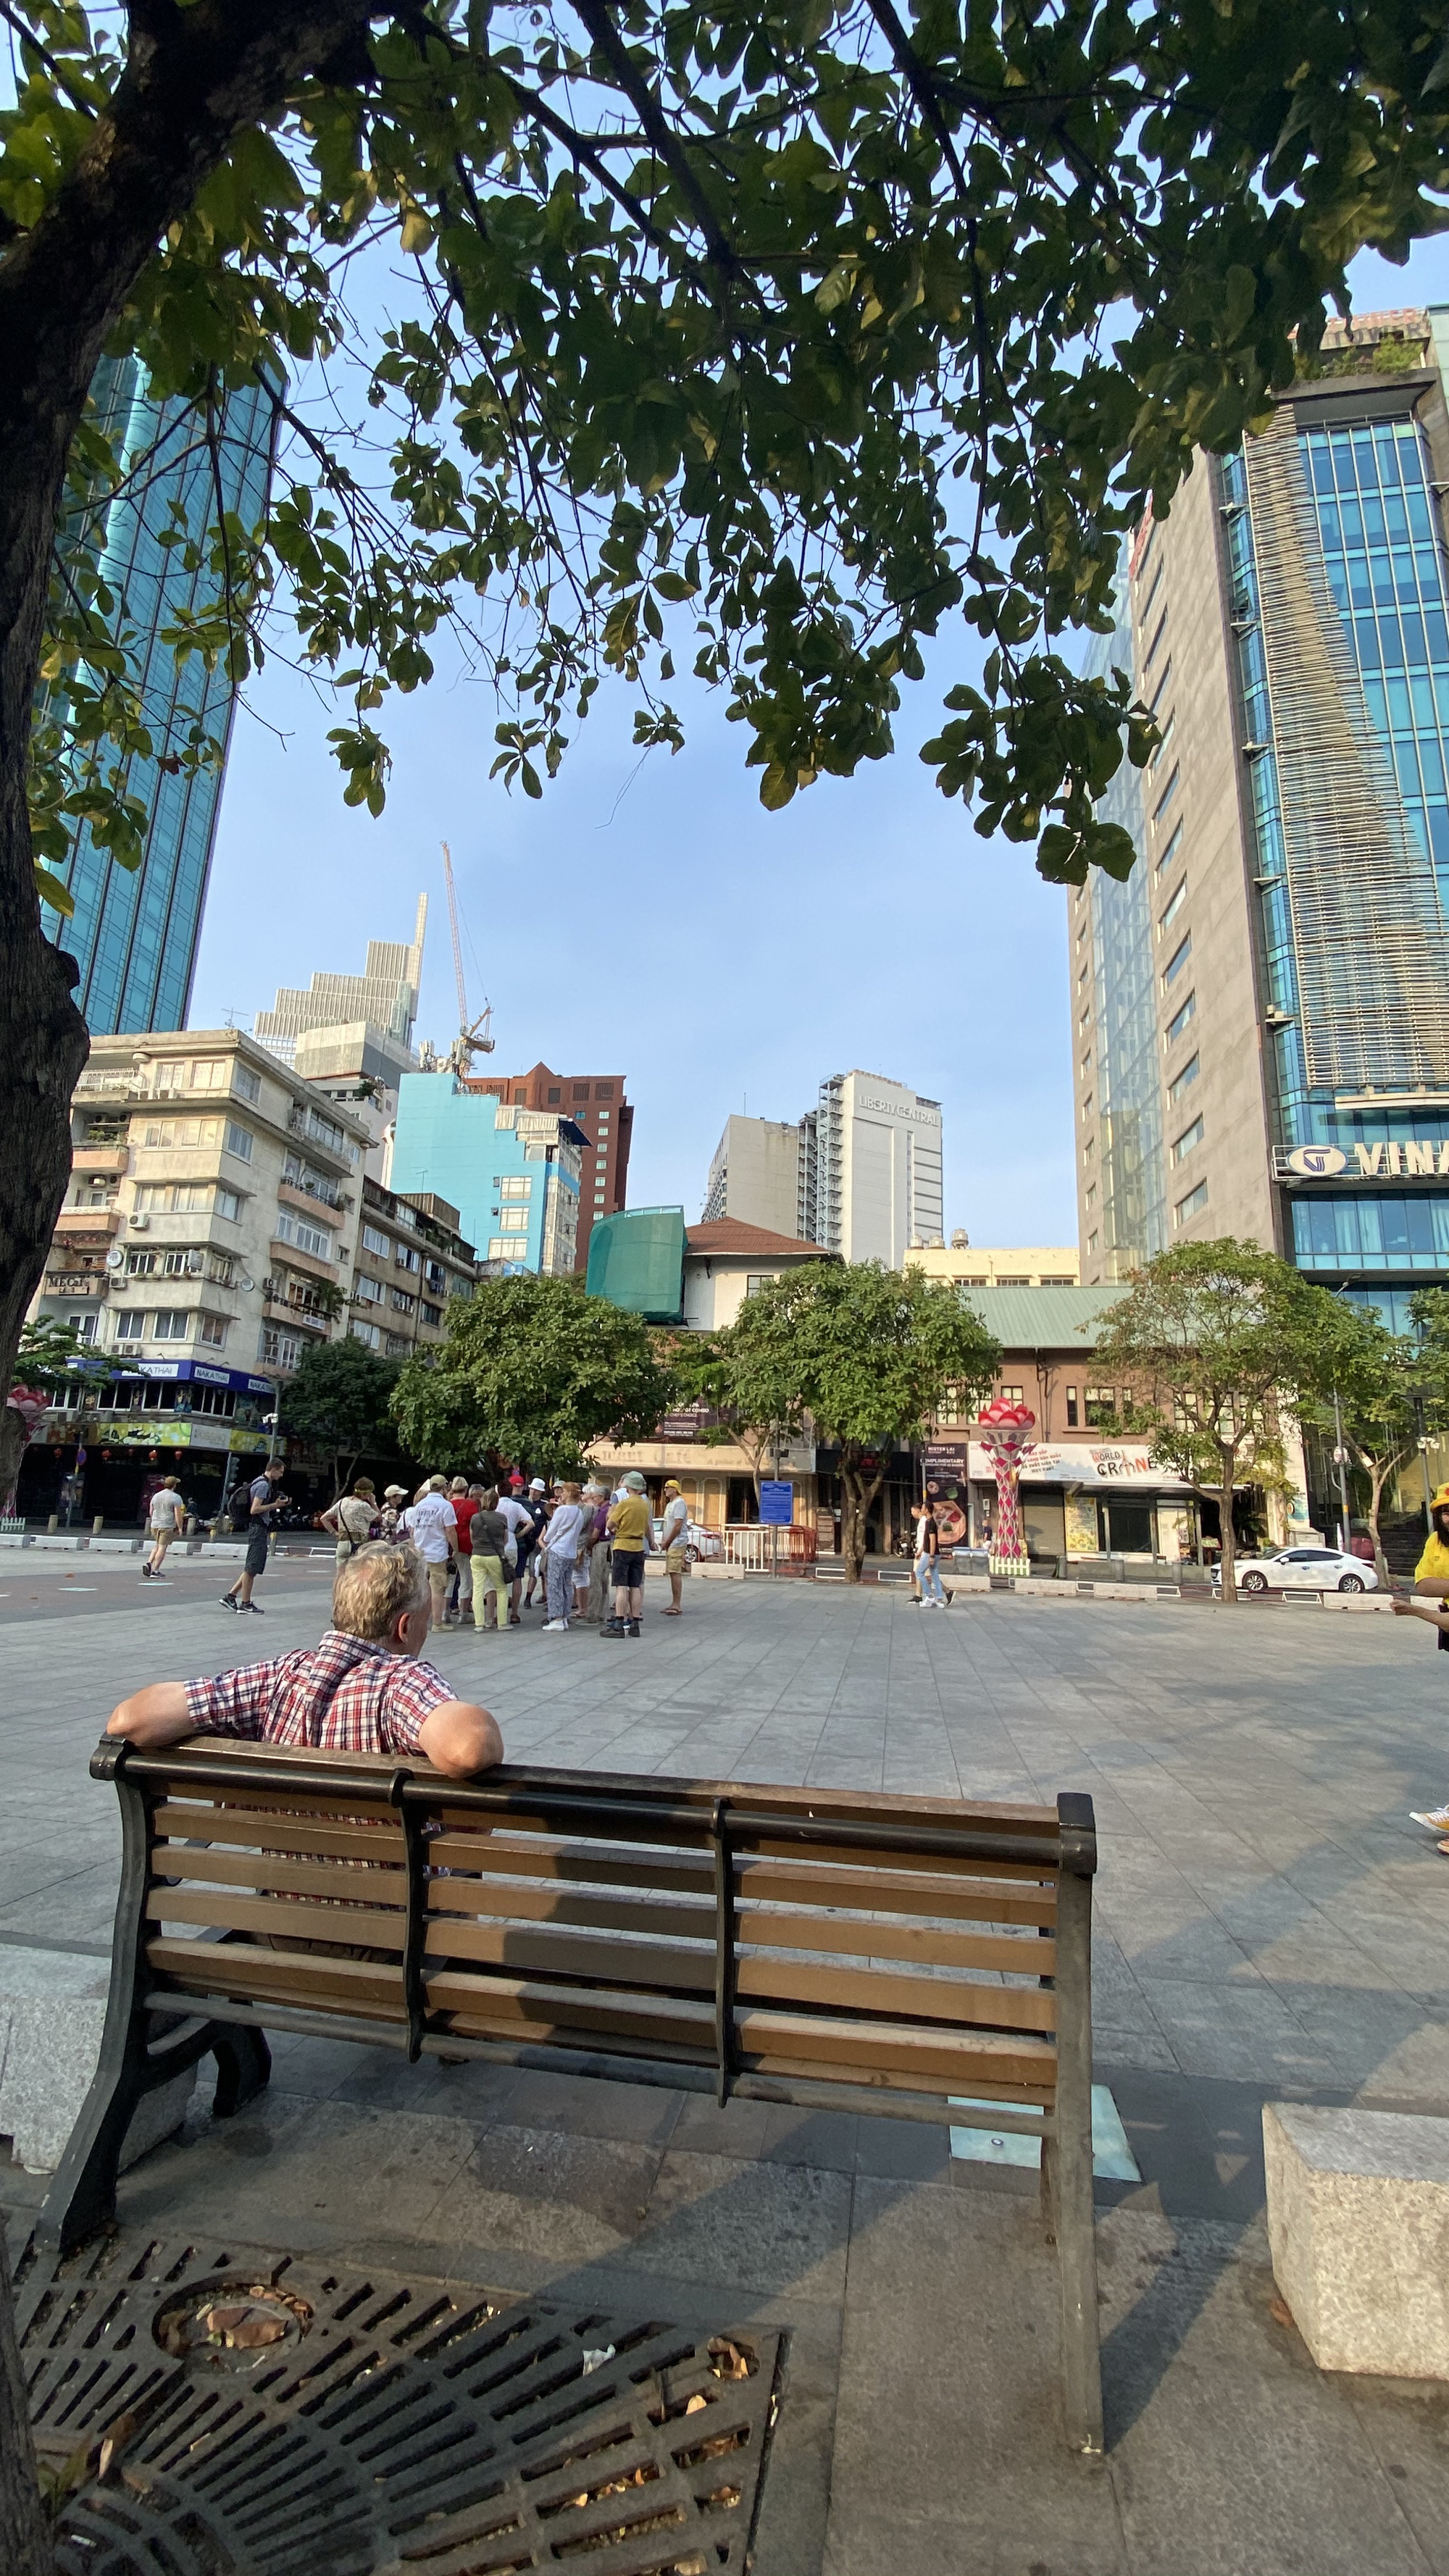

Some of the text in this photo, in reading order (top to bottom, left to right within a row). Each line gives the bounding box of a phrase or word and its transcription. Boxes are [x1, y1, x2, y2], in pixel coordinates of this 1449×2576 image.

[859, 1095, 938, 1126] LIBERTY CENTRAL
[1092, 1451, 1121, 1463] WORLD
